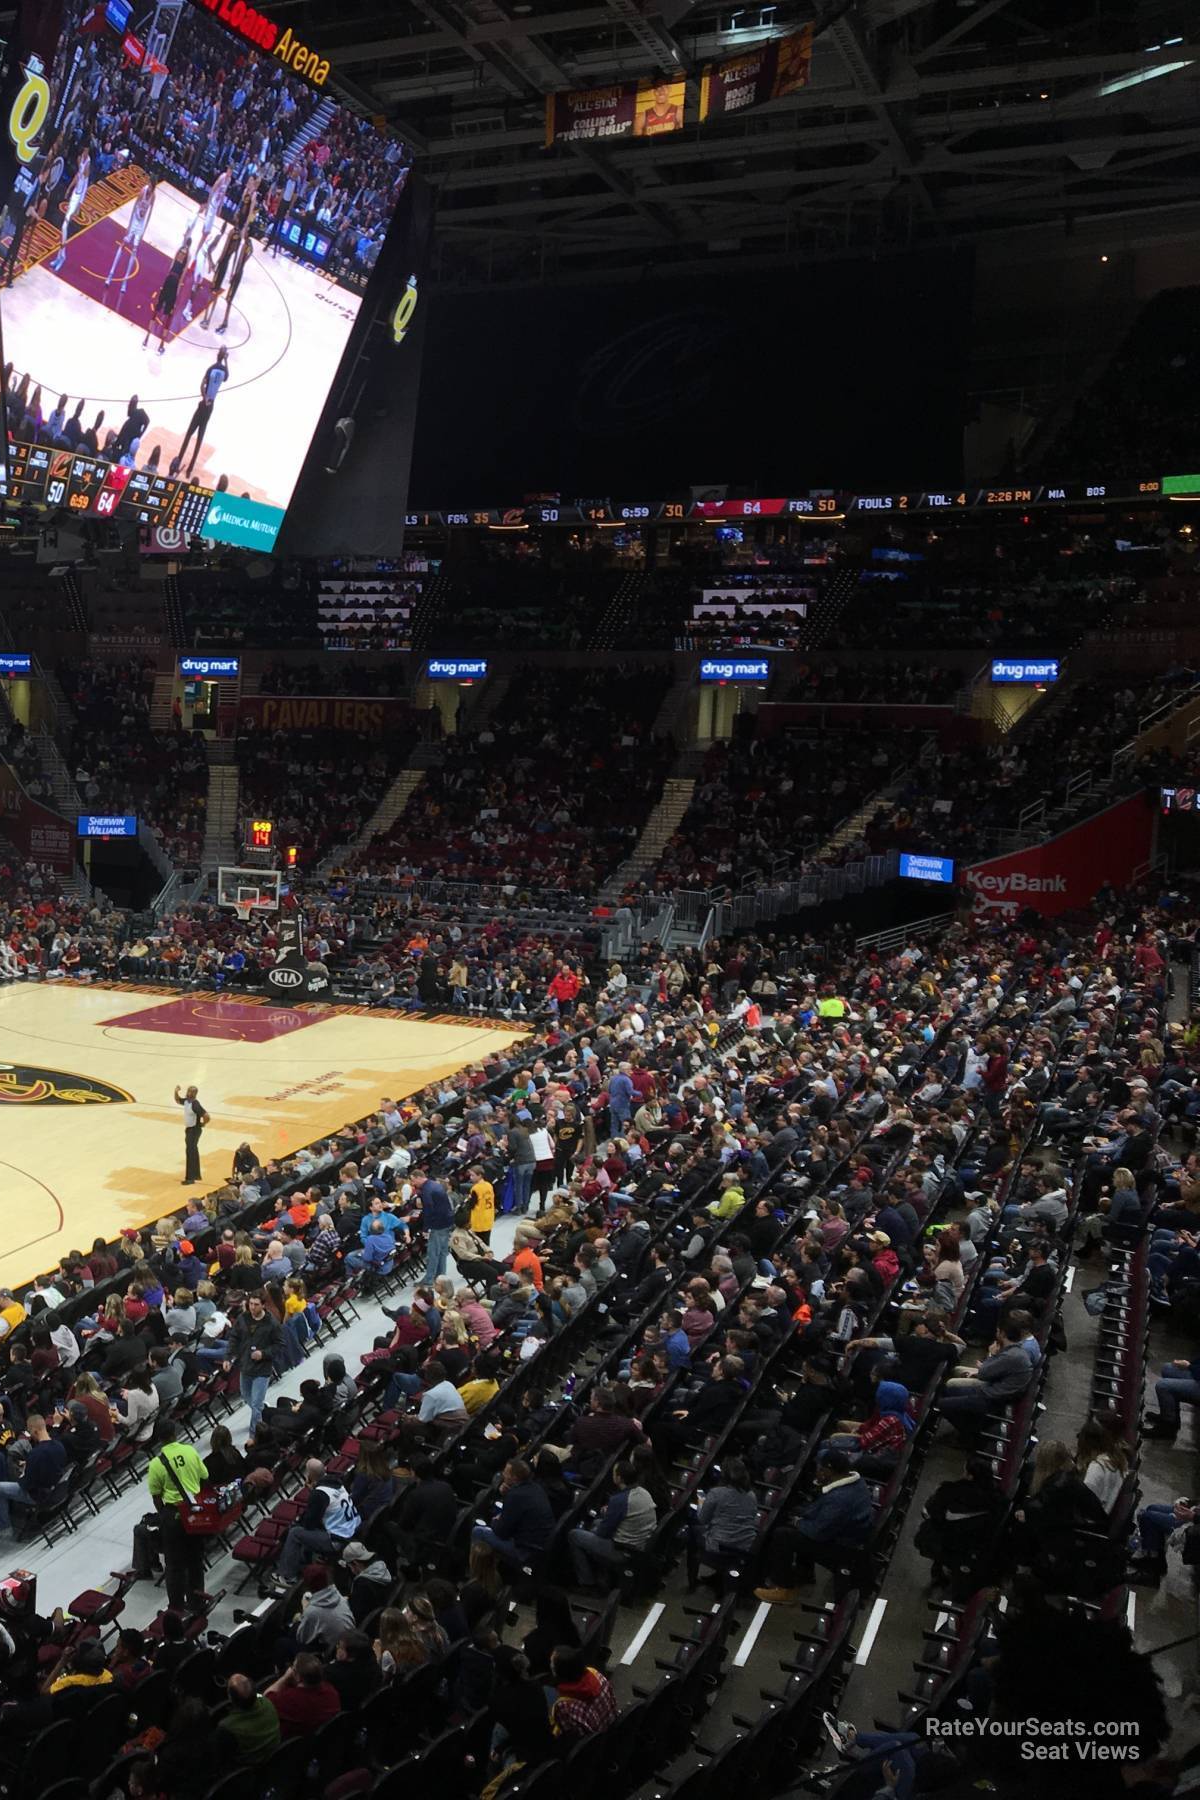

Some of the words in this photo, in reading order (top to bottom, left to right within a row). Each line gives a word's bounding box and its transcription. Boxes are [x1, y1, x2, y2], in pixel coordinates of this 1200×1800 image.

[218, 0, 278, 50] Loans
[273, 28, 330, 86] Arena
[573, 97, 618, 113] ALL-STAR
[9, 69, 51, 164] Q
[573, 114, 616, 130] COLLIN'S
[48, 481, 65, 504] 50
[1048, 489, 1066, 499] MIA
[1086, 486, 1106, 497] BOS
[1140, 482, 1159, 492] 6:00
[69, 493, 90, 510] 6:59
[97, 491, 116, 513] 64
[858, 497, 892, 510] FOULS
[899, 496, 908, 508] 2
[927, 495, 952, 506] TOL:
[957, 493, 966, 505] 4
[987, 491, 1012, 503] 2:26
[1015, 491, 1031, 501] PM
[621, 506, 650, 518] 6:59
[743, 502, 761, 514] 64
[789, 500, 813, 512] FG%
[819, 499, 836, 511] 50
[423, 513, 430, 525] 1
[447, 513, 469, 525] FG%
[474, 512, 489, 524] 35
[541, 508, 559, 521] 50
[589, 508, 605, 520] 14
[221, 512, 250, 528] MEDICAL
[250, 520, 278, 536] MUTUAL
[101, 635, 161, 645] WESTFIELD
[13, 658, 31, 668] mart
[181, 659, 207, 674] drug
[209, 658, 238, 672] mart
[429, 661, 454, 677] drug
[457, 660, 487, 674] mart
[702, 662, 732, 678] drug
[735, 661, 768, 675] mart
[993, 662, 1023, 680] drug
[1026, 661, 1058, 676] mart
[1165, 796, 1170, 808] 1
[88, 817, 125, 828] SHERWIN
[252, 822, 272, 832] 6:59
[87, 826, 126, 836] WILLIAMS
[253, 832, 270, 846] 14
[908, 855, 943, 870] SHERWIN
[906, 865, 943, 881] WILLIAMS
[967, 871, 1067, 894] KeyBank
[274, 971, 298, 984] KIA
[264, 1083, 313, 1102] Quicken
[304, 1071, 343, 1085] Loans
[308, 1082, 345, 1096] Arena
[173, 1455, 186, 1470] 13
